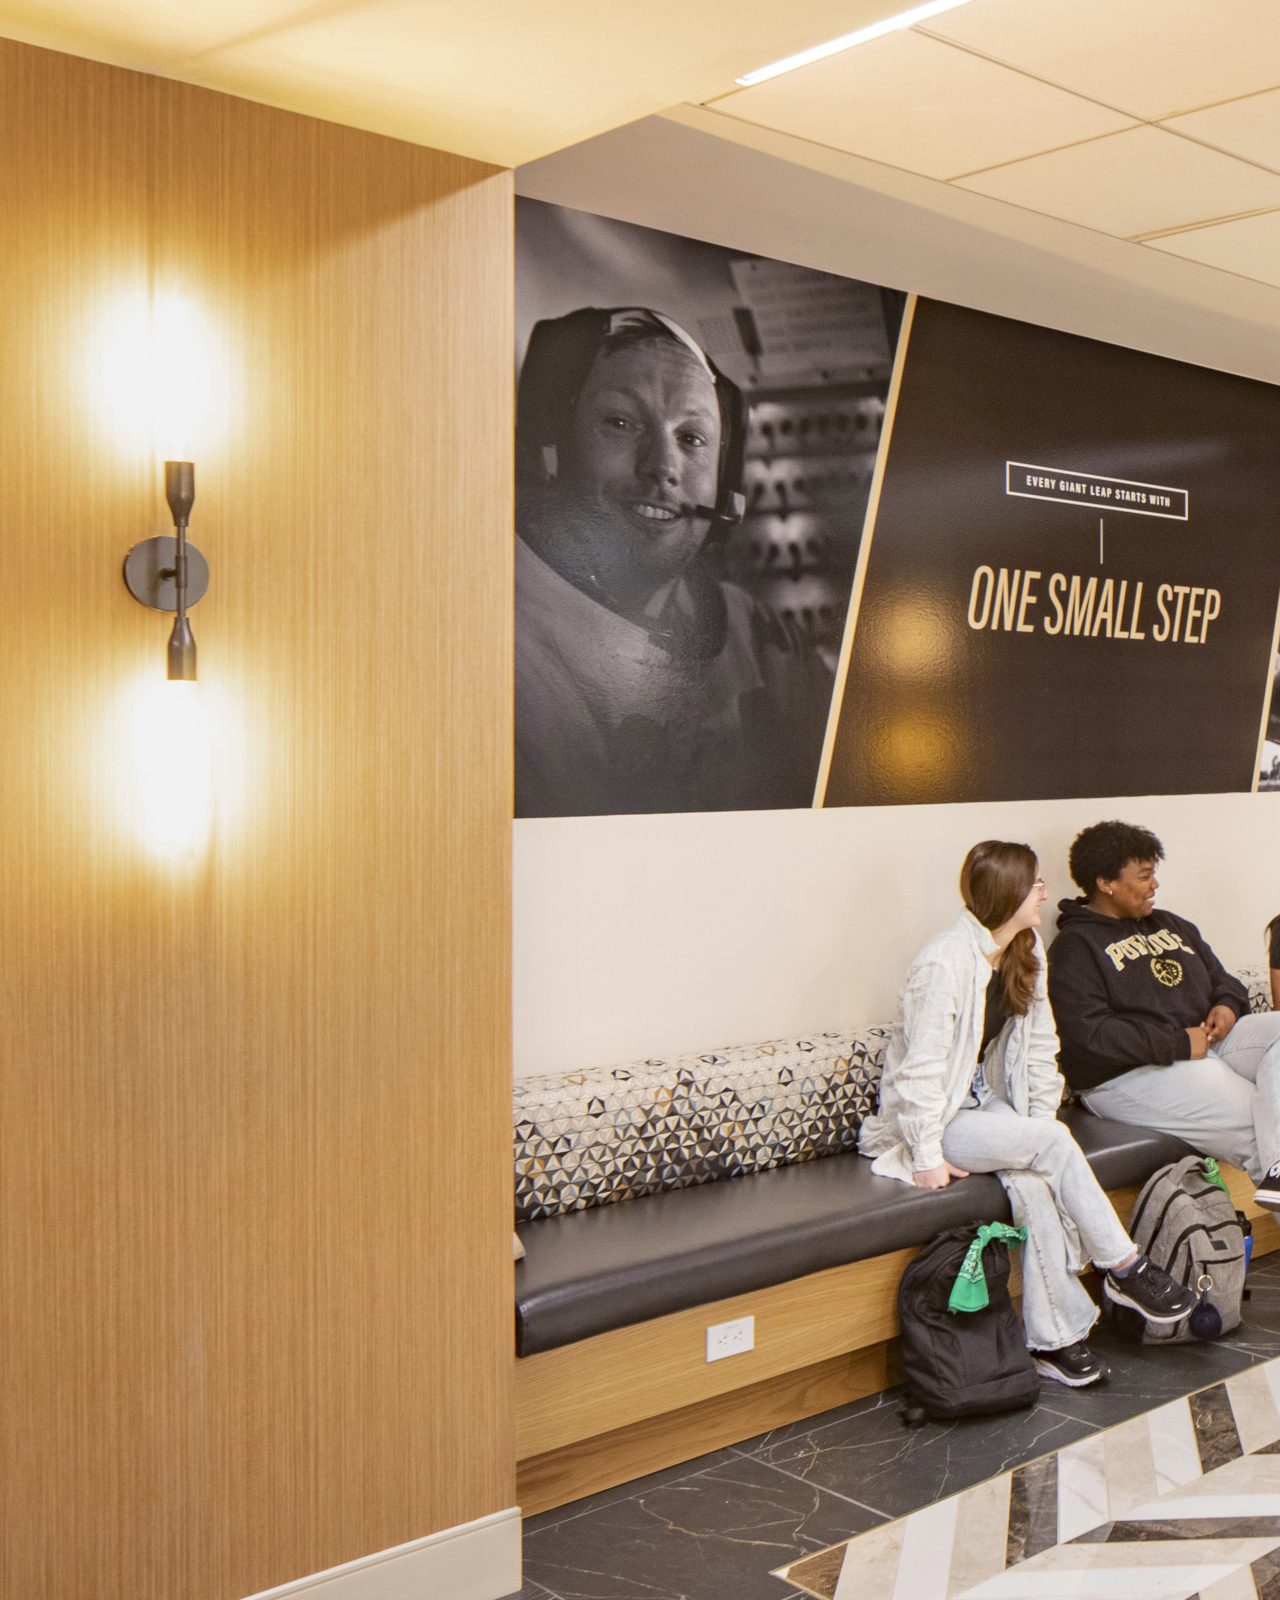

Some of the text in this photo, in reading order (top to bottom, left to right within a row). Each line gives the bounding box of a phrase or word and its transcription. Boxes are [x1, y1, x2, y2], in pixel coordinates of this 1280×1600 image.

[1026, 474, 1171, 507] EVERY GIANT LEAP STARTS WITH
[967, 565, 1221, 644] ONE SMALL STEP
